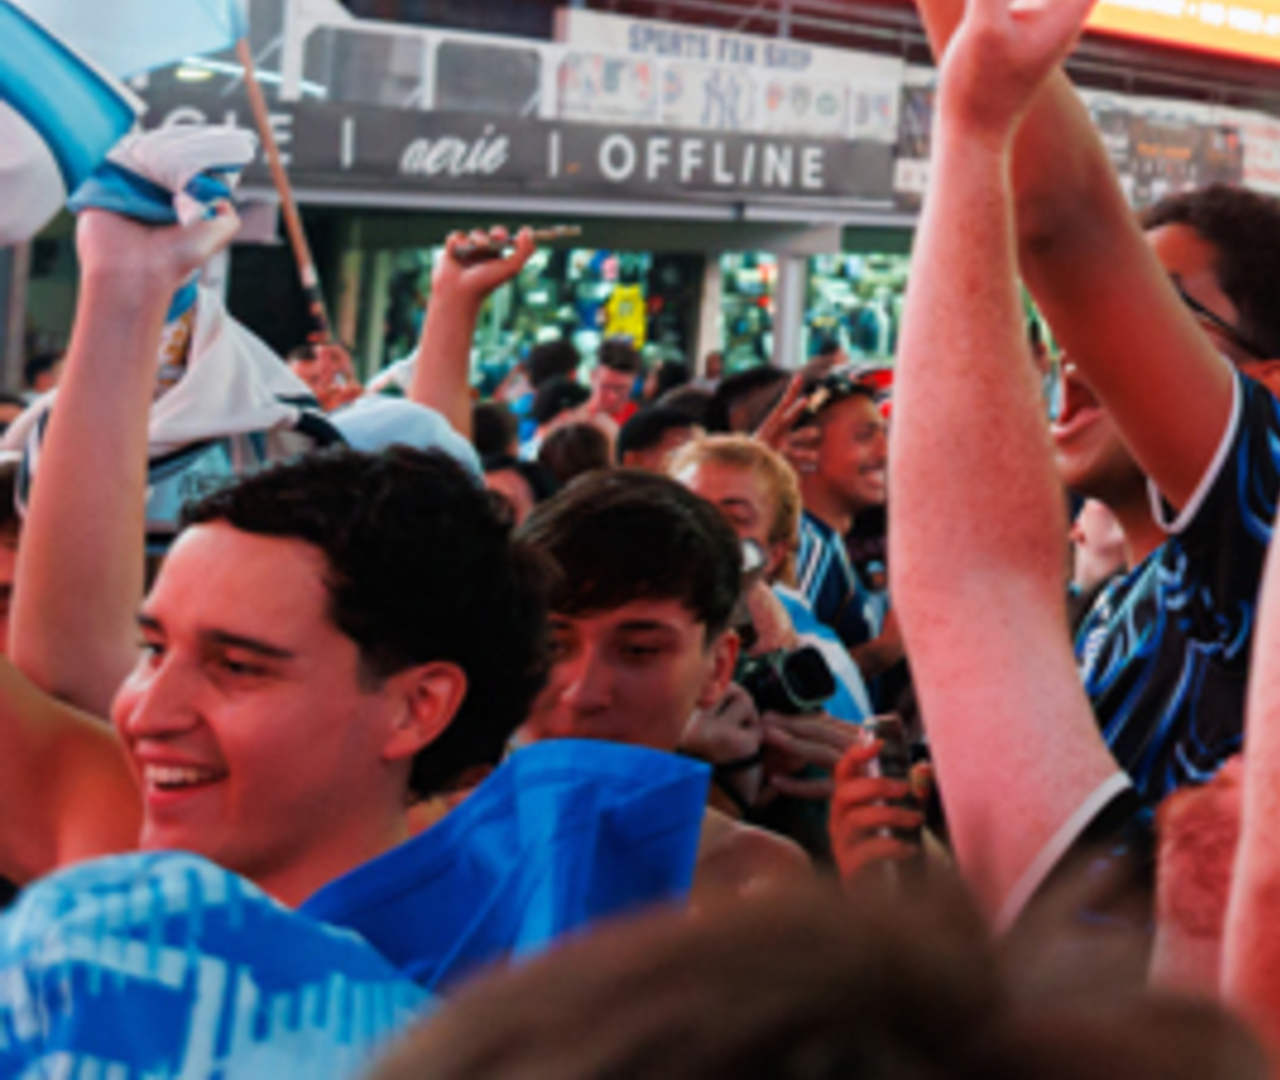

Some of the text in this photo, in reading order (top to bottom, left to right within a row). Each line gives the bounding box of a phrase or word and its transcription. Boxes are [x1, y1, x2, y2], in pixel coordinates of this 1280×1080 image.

[627, 23, 711, 63] SPORTS
[762, 42, 813, 72] SHOP
[401, 123, 510, 176] aerie
[599, 133, 826, 190] OFFLINE
